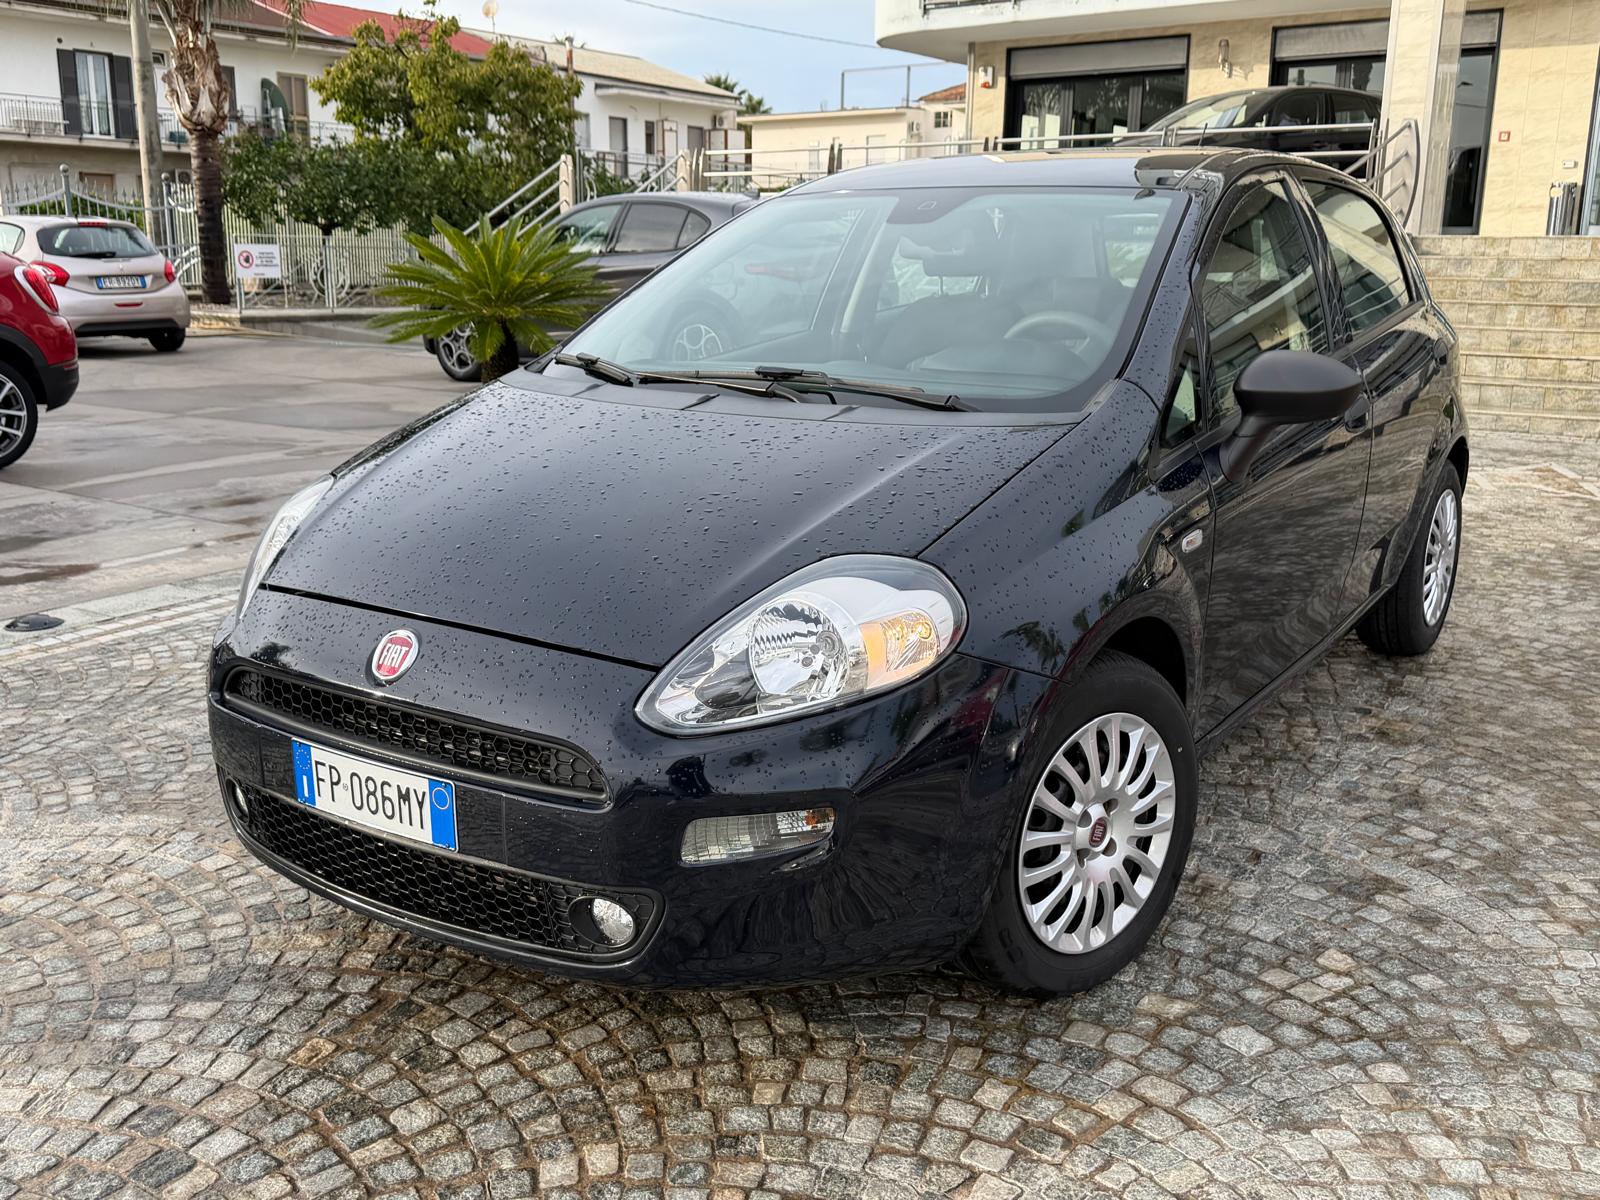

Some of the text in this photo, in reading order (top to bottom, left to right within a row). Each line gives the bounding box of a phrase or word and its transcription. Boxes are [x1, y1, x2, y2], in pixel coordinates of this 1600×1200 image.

[378, 642, 410, 668] FIAT
[314, 759, 426, 830] FP 086MY
[1092, 824, 1105, 841] FIAT
